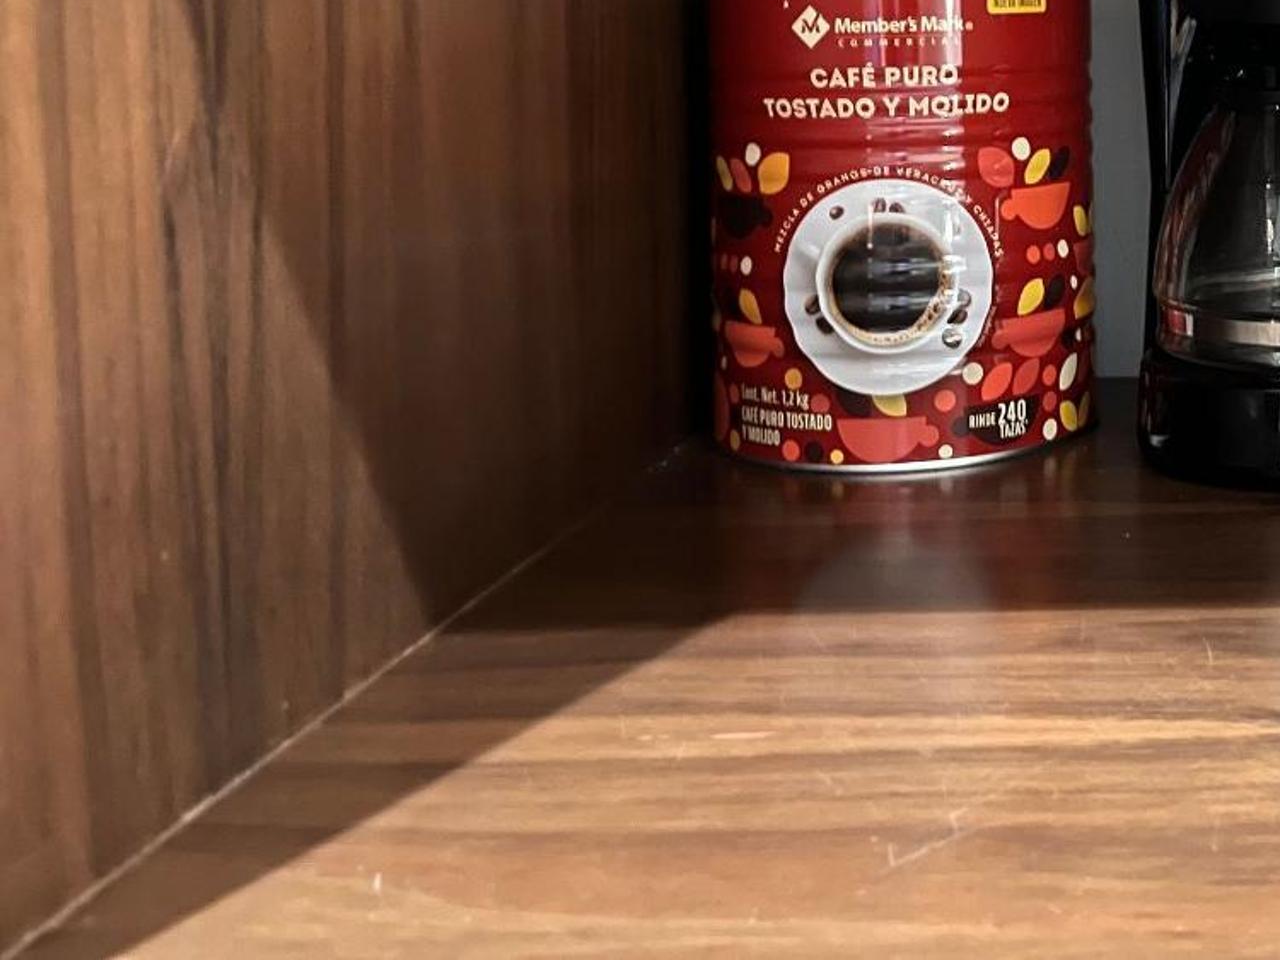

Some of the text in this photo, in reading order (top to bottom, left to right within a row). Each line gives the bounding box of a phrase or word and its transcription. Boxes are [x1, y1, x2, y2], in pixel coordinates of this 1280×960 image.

[834, 16, 917, 34] Member's
[810, 62, 959, 88] CAFÉ PURO
[763, 92, 1010, 119] TOSTADO Y MOLIDO
[796, 389, 810, 410] kg
[760, 408, 784, 428] PURO
[786, 412, 832, 431] TOSTADO
[969, 399, 1027, 428] RINDE 240
